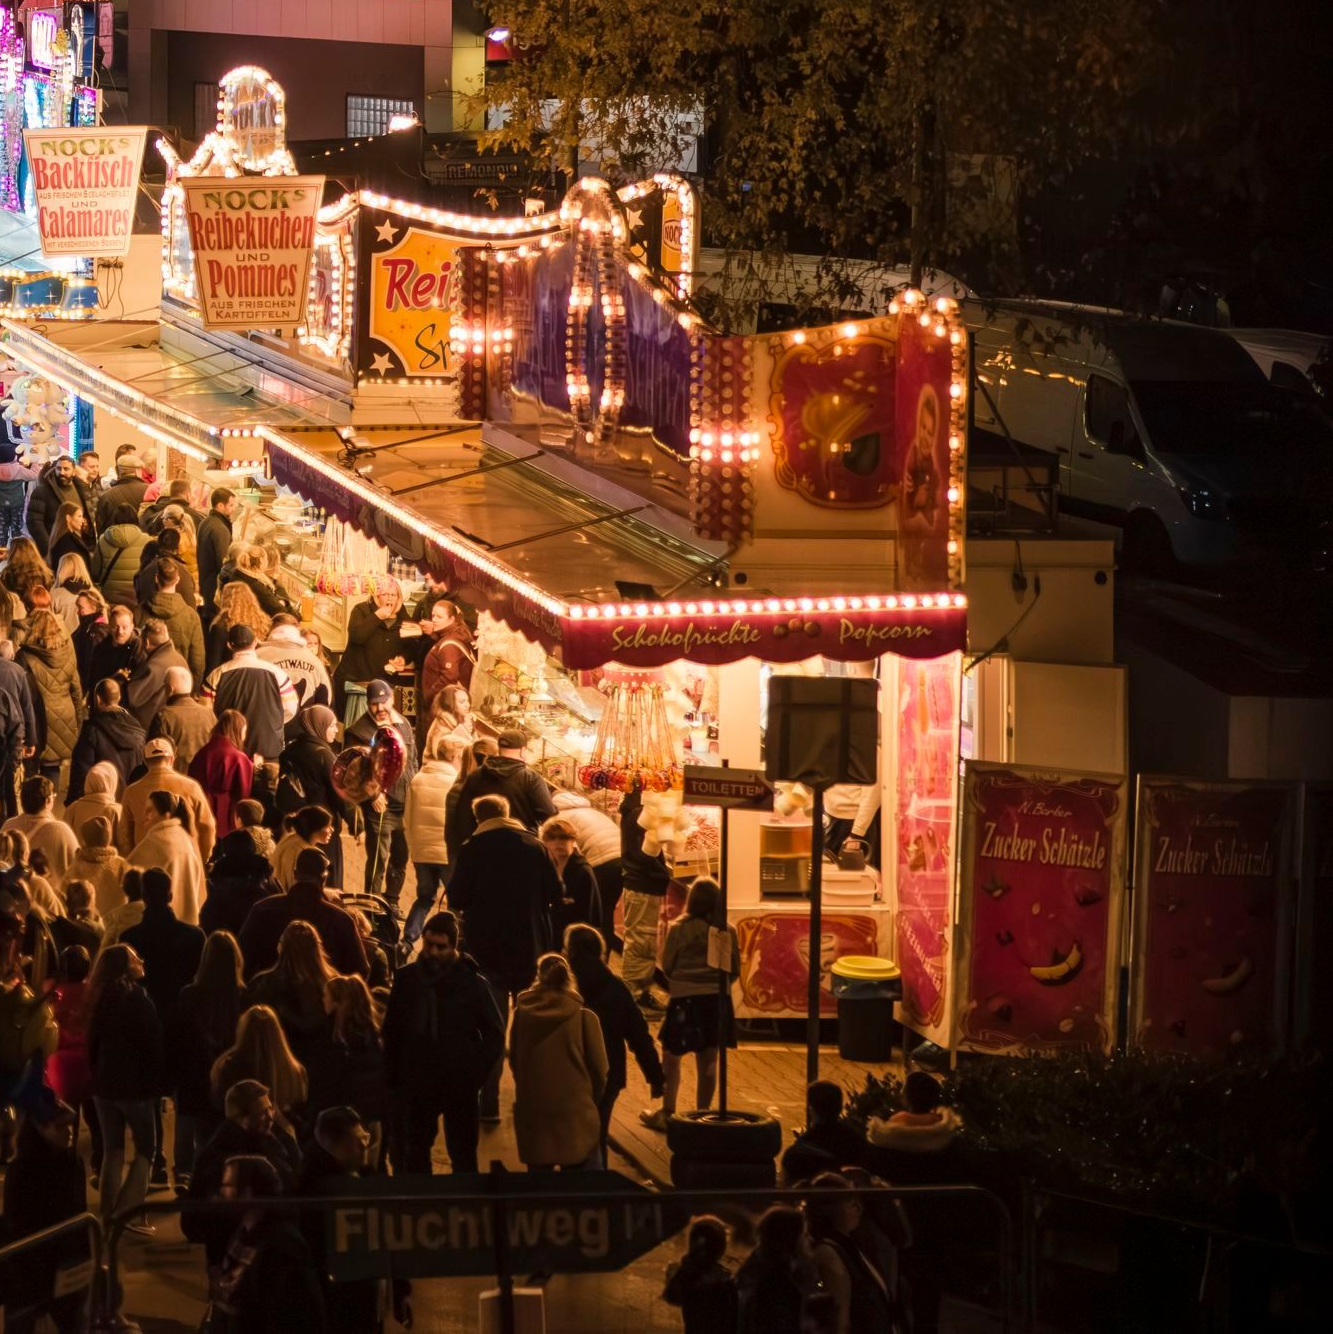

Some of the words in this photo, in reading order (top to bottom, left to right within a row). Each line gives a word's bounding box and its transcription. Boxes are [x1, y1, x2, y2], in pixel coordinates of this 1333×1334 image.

[33, 155, 132, 190] Backfisch
[71, 200, 98, 208] UND
[39, 205, 130, 239] Calamares
[191, 210, 315, 251] Reibekuchen
[235, 252, 270, 262] UND
[207, 259, 297, 299] Pommes
[382, 258, 458, 310] Rei
[210, 300, 234, 309] AUS
[238, 299, 296, 308] FRISCHEN
[215, 310, 290, 320] KARTOFFELN
[611, 619, 762, 654] Schokofrüchte
[838, 618, 933, 641] Popcorn
[690, 780, 764, 796] TOILETTEN
[980, 821, 1037, 862] Zucker
[1039, 827, 1107, 869] Schätzle
[1154, 834, 1208, 874] Zucker
